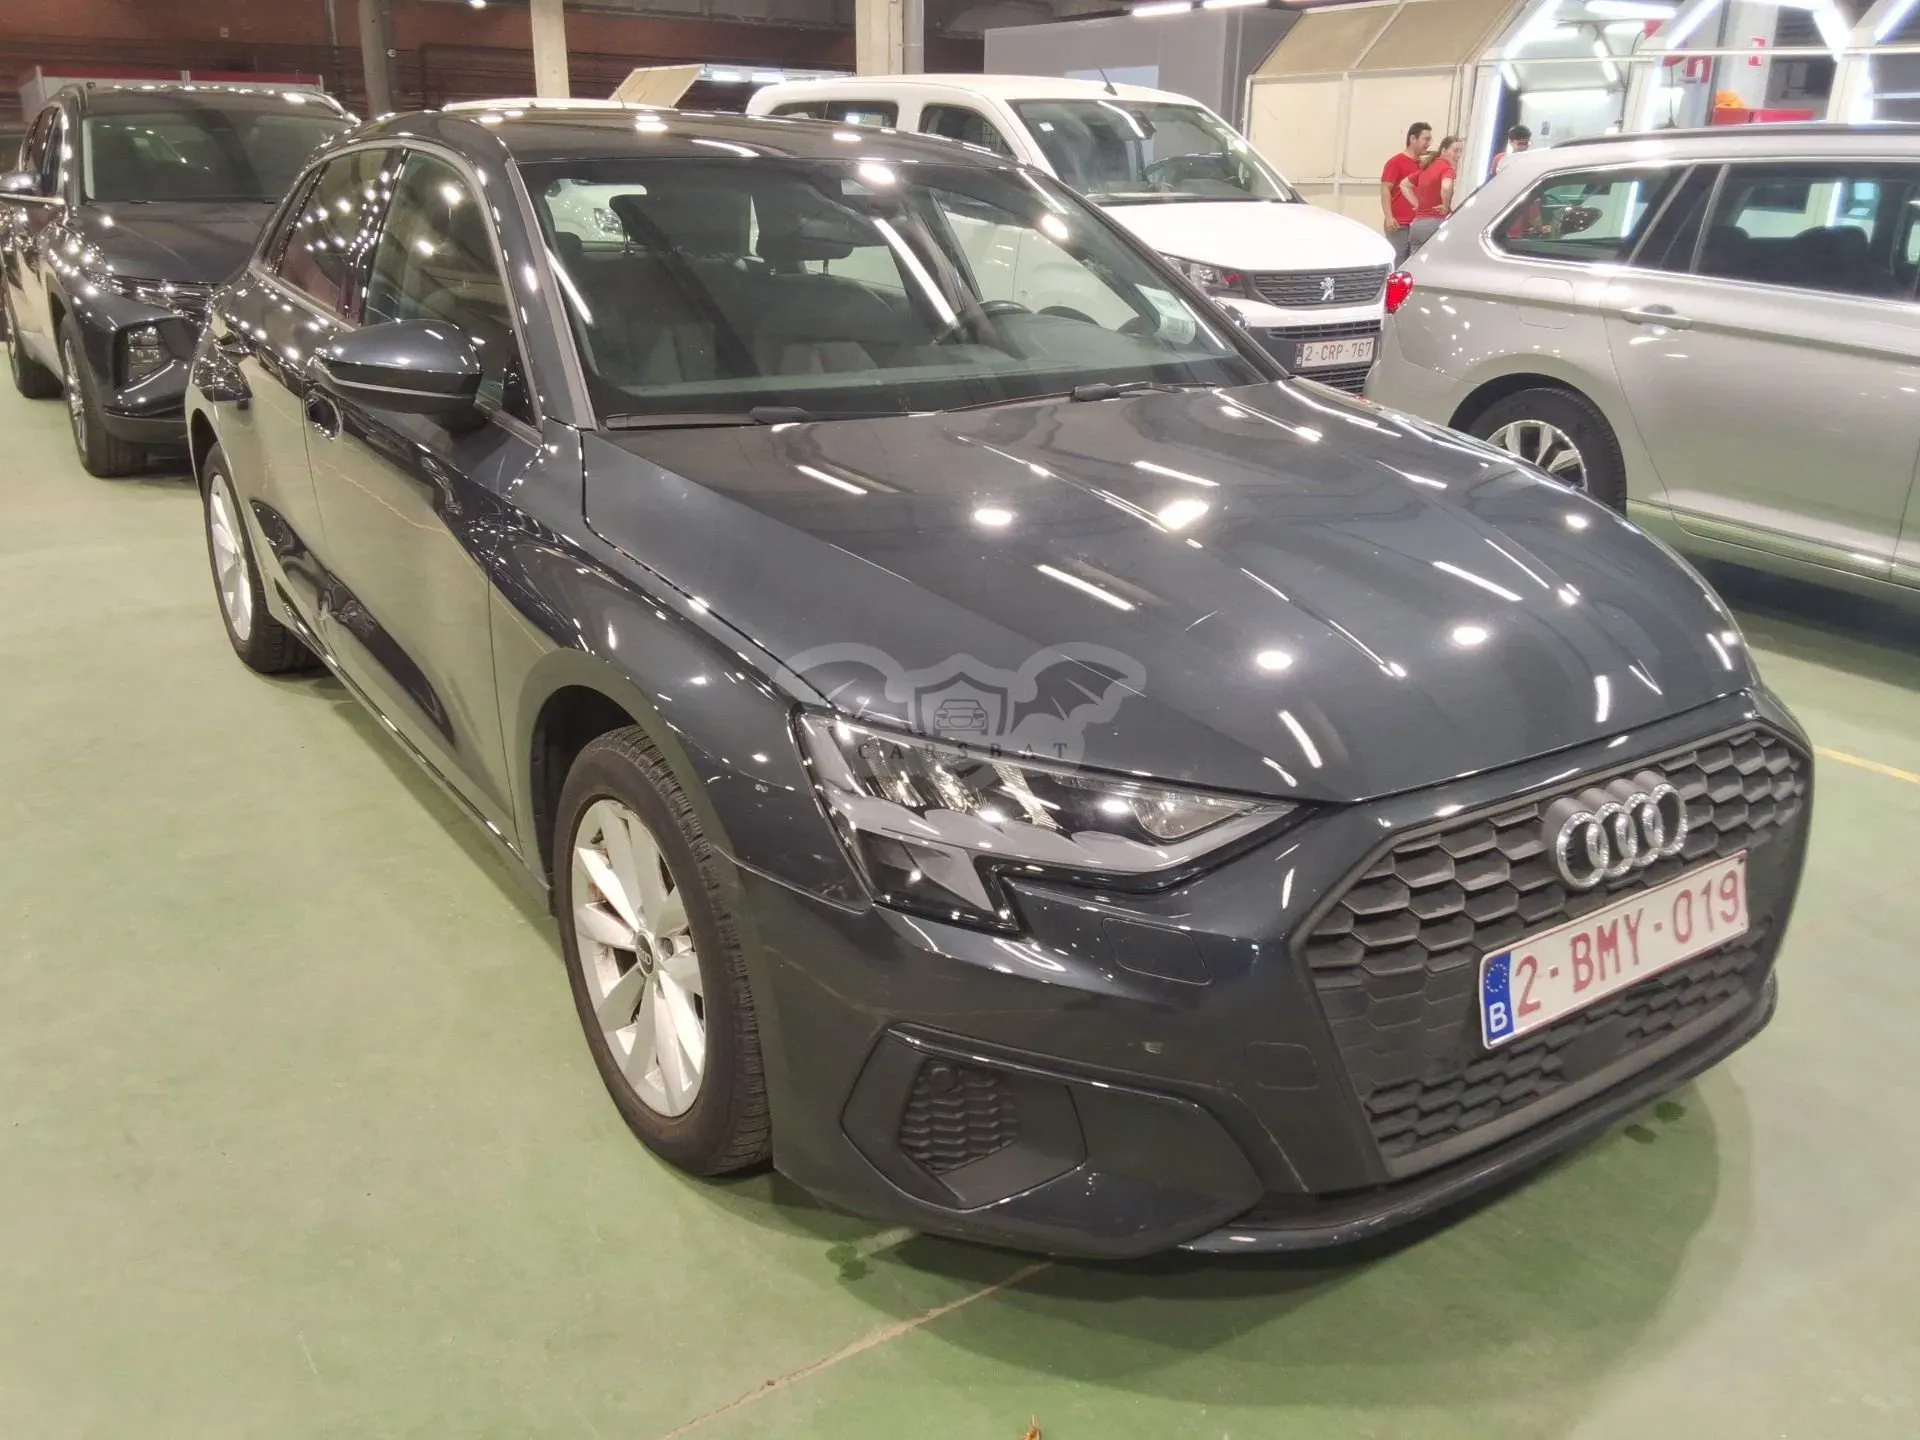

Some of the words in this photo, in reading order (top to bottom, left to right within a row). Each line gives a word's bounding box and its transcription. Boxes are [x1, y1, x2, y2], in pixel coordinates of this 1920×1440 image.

[1304, 341, 1373, 362] 2-CRP-767
[1488, 1000, 1509, 1033] B
[1514, 869, 1739, 1017] 2-BMY-019
